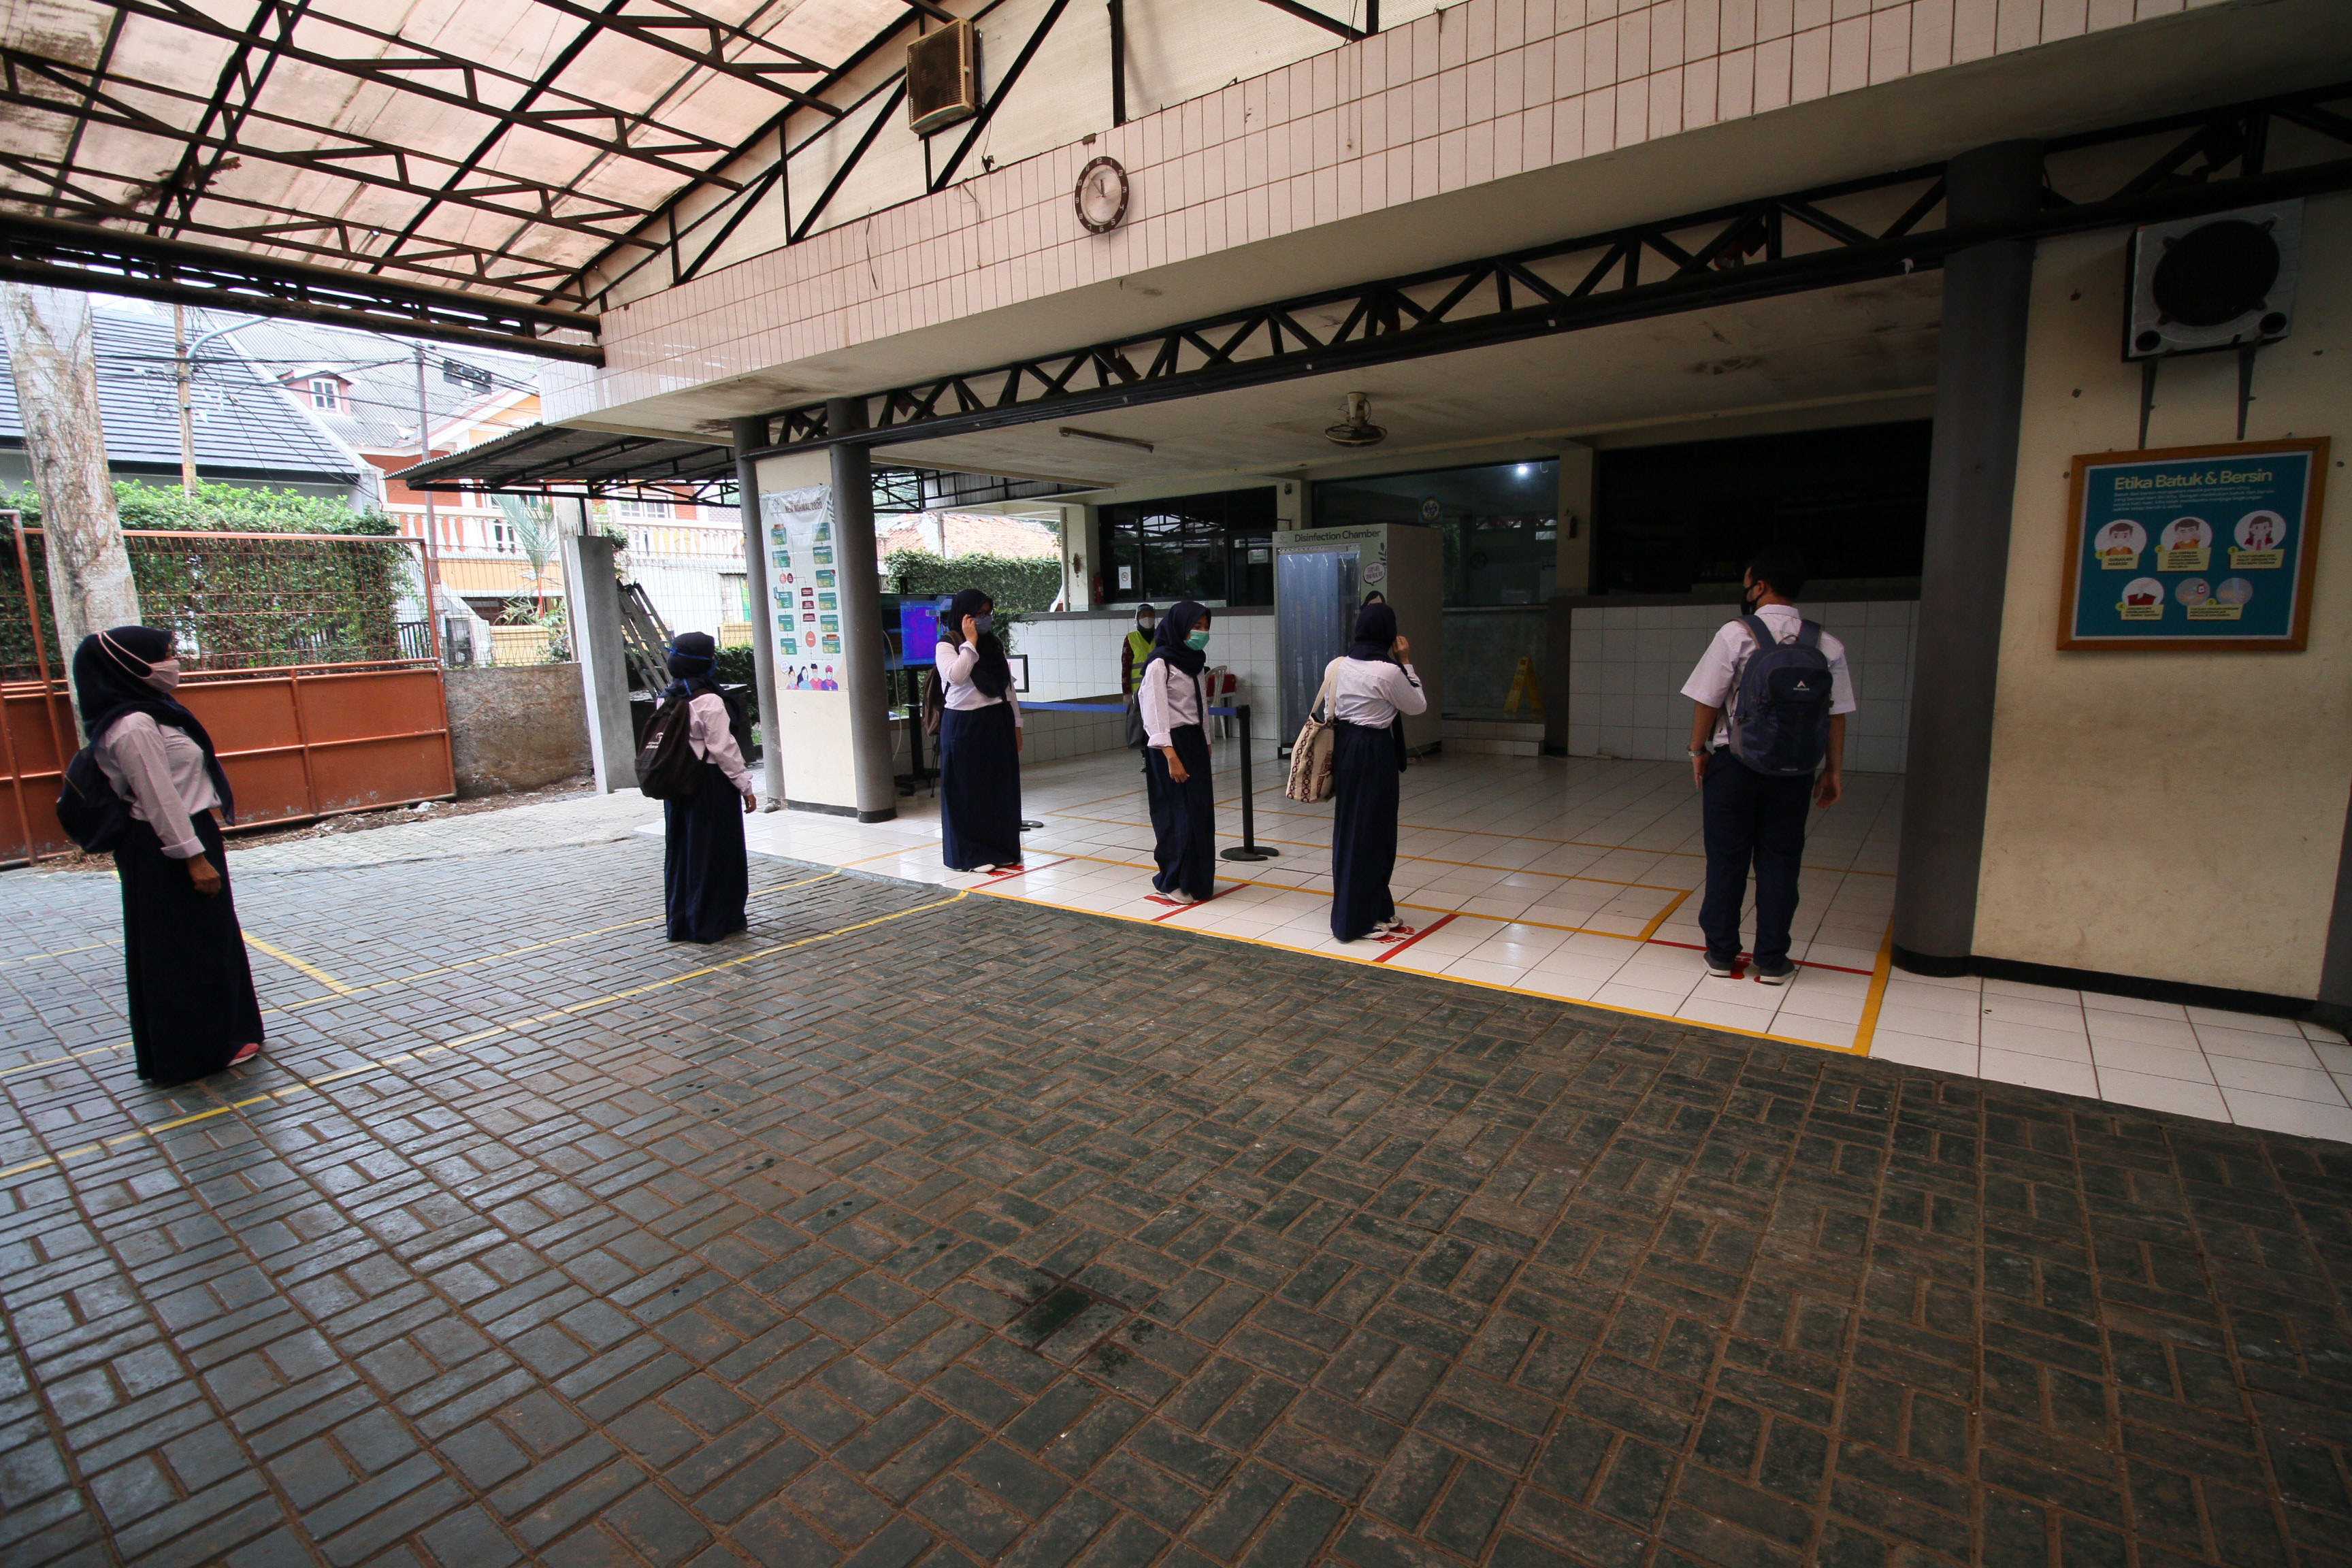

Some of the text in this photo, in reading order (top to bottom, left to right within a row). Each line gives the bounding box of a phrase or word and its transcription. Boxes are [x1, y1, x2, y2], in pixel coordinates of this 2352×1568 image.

[2114, 468, 2273, 490] Etika Batuk & Bersin
[811, 502, 823, 510] 2020
[1294, 529, 1381, 542] Disinfection Chamber
